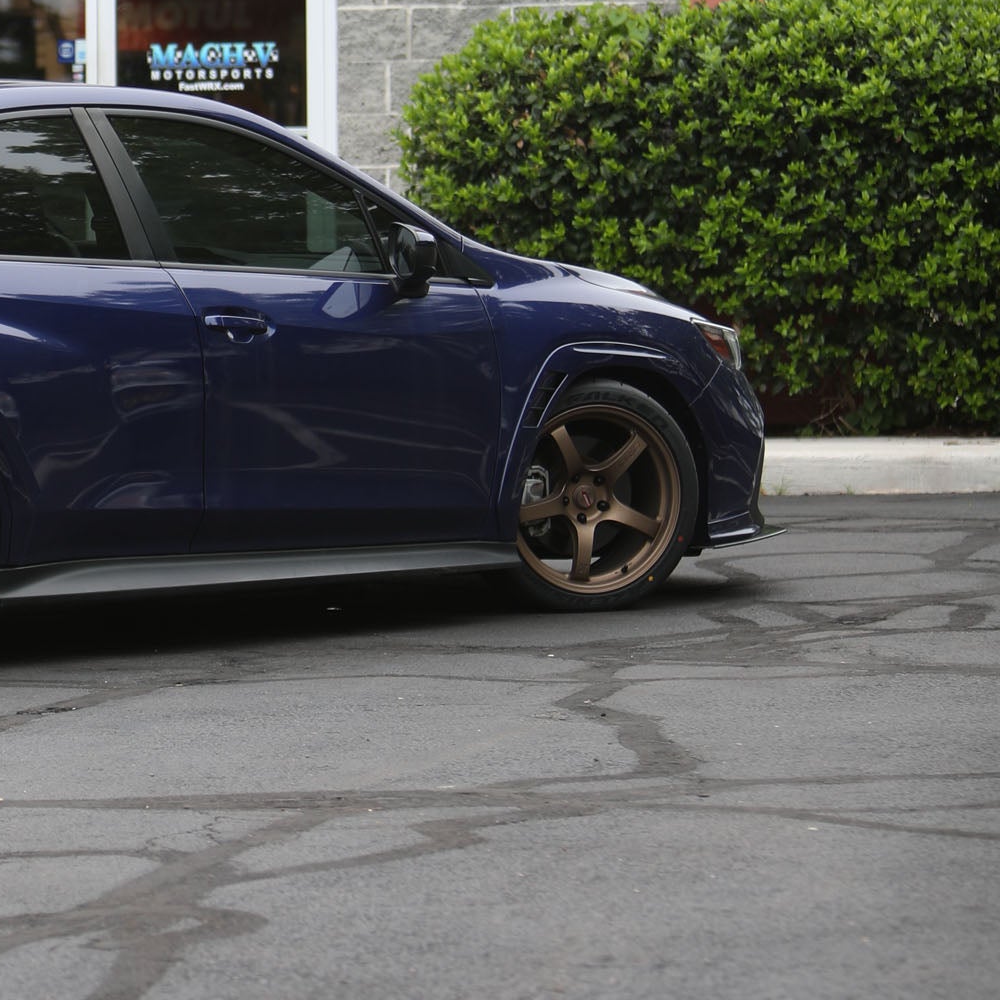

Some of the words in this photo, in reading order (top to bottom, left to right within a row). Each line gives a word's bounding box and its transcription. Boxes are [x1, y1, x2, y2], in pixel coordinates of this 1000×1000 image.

[150, 42, 246, 70] MACH
[252, 41, 277, 68] V
[150, 68, 275, 81] MOTORSPORTS
[178, 81, 244, 93] FastWRX.com
